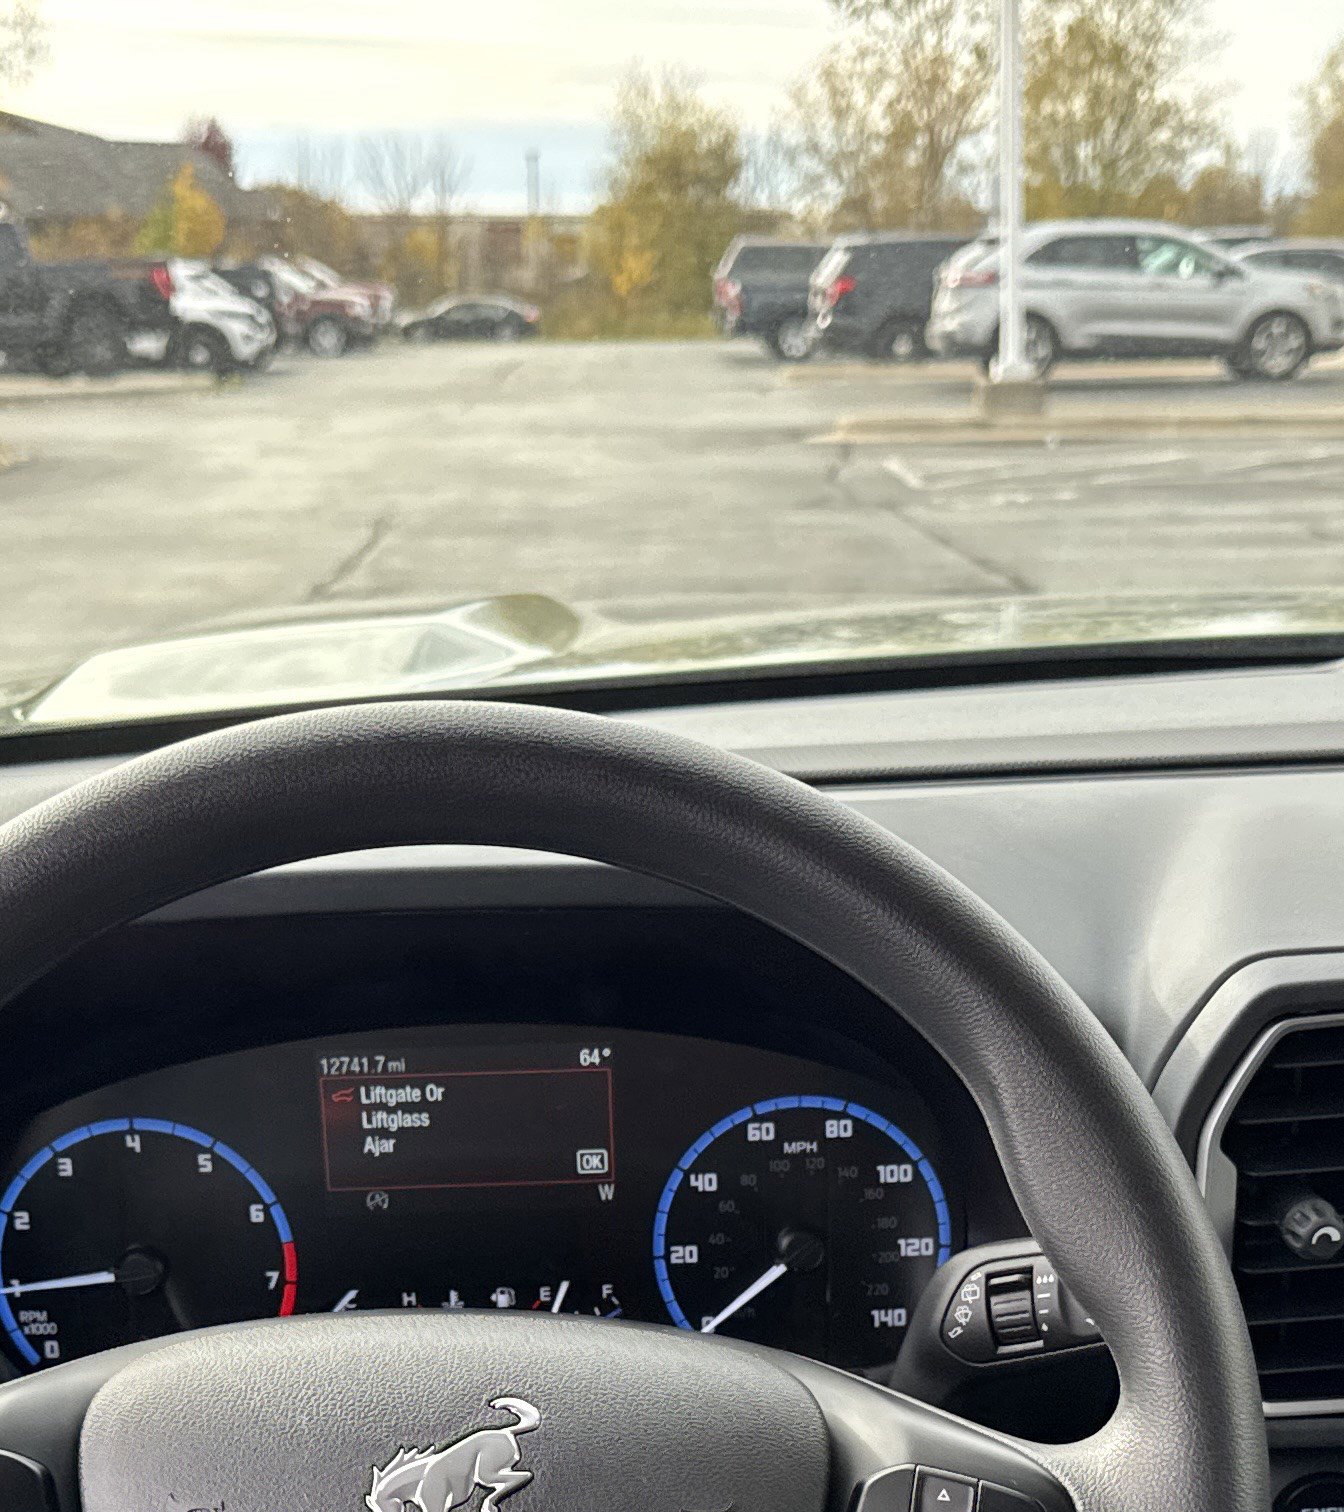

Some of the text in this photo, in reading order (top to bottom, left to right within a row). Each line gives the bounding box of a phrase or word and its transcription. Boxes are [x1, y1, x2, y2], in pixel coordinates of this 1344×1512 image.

[320, 1056, 385, 1075] 12741.7
[360, 1084, 445, 1106] Liftgate Or
[362, 1111, 430, 1131] Liftglass
[825, 1120, 852, 1139] 80
[747, 1122, 774, 1141] 60
[125, 1135, 141, 1153] 4
[363, 1137, 396, 1157] Ajar
[783, 1141, 817, 1155] MPH
[57, 1158, 73, 1177] 3
[198, 1154, 213, 1173] 5
[582, 1155, 603, 1170] OK
[690, 1173, 717, 1192] 40
[876, 1165, 912, 1184] 100
[598, 1184, 615, 1200] W
[14, 1212, 30, 1230] 2
[250, 1205, 264, 1223] 6
[670, 1245, 698, 1264] 20
[898, 1238, 933, 1257] 120
[266, 1272, 280, 1289] 7
[403, 1293, 417, 1306] H
[539, 1286, 551, 1301] E
[602, 1284, 613, 1298] F
[18, 1310, 48, 1324] RPM
[871, 1309, 907, 1328] 140
[44, 1339, 60, 1359] 0
